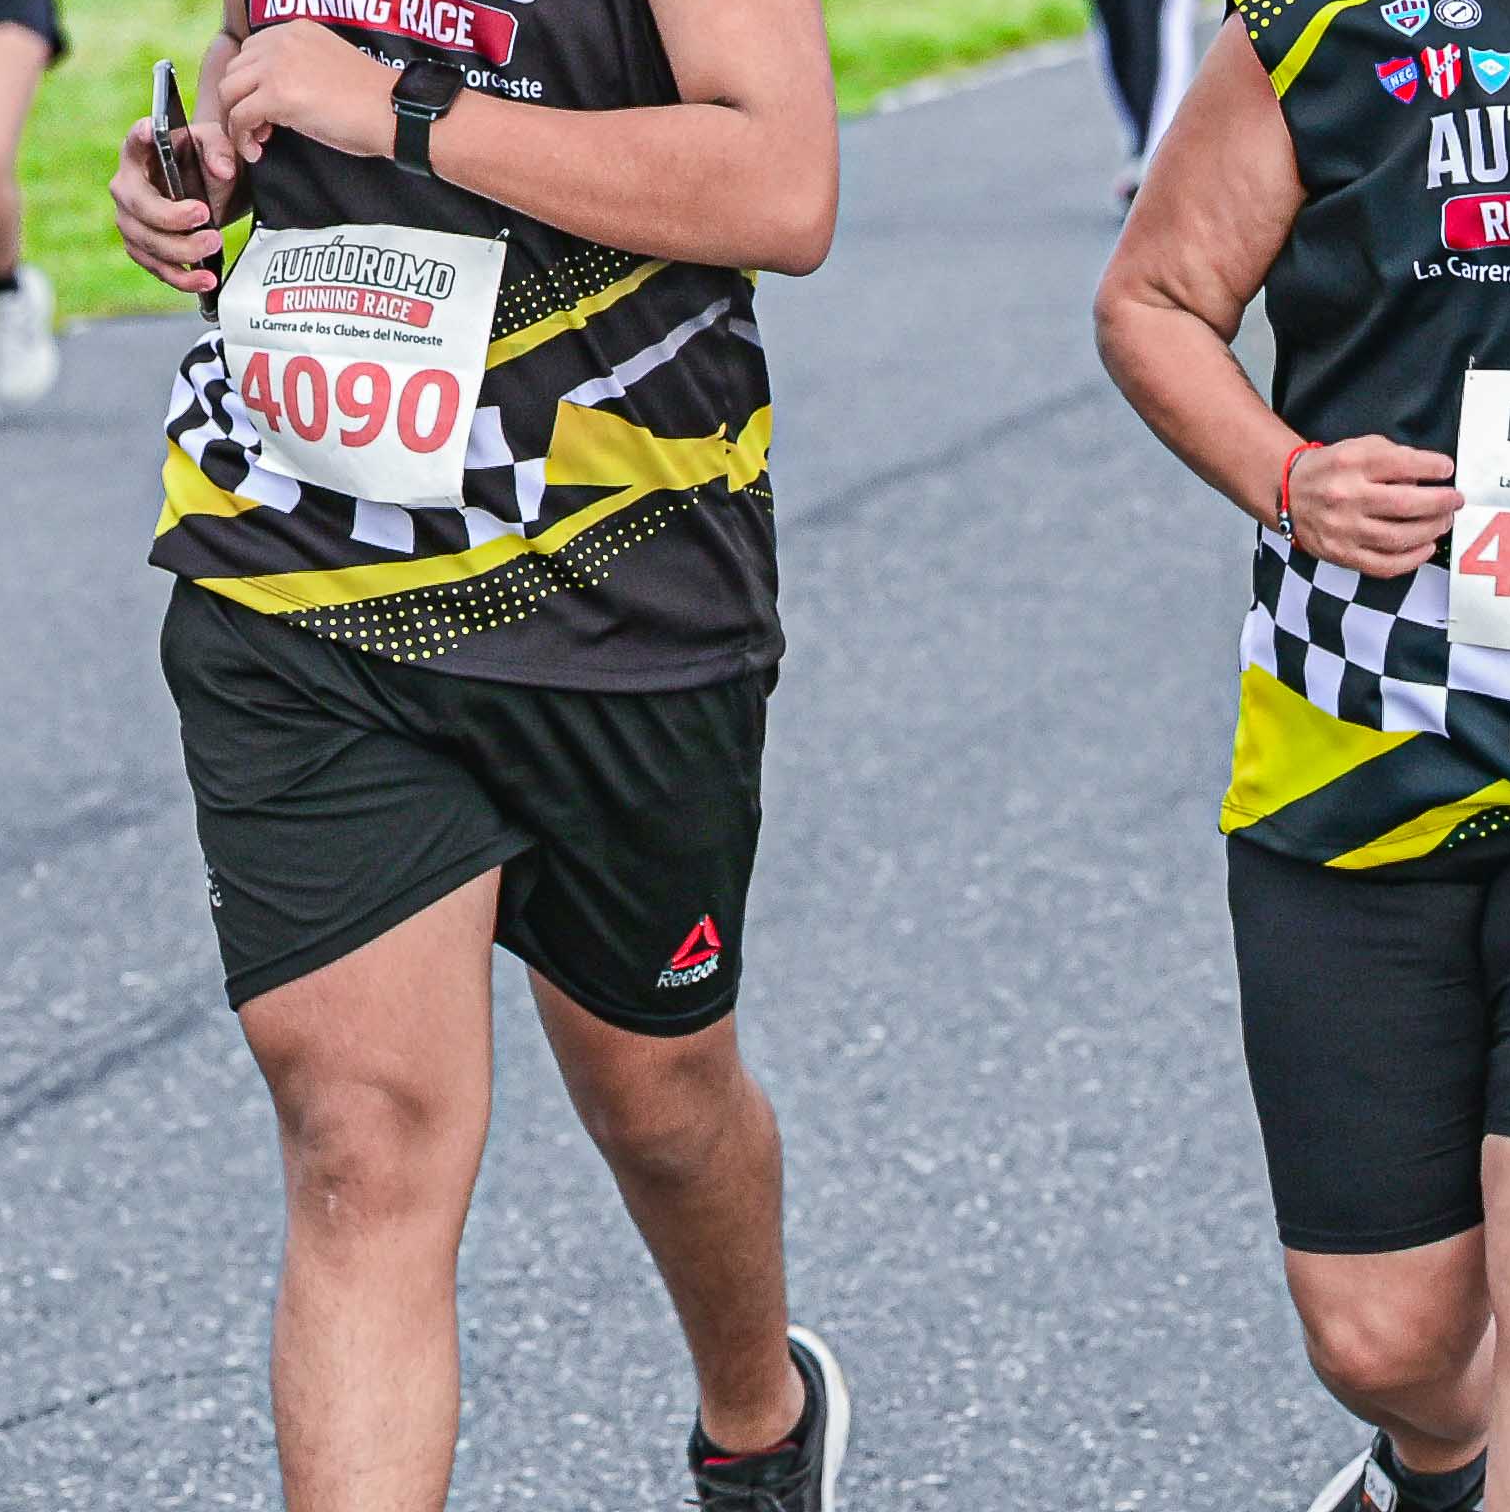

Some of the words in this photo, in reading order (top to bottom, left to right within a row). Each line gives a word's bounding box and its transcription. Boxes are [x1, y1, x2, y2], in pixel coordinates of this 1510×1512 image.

[1390, 67, 1413, 86] NEC
[263, 235, 456, 300] AUTÓDROMO
[1413, 260, 1442, 280] La
[282, 290, 359, 312] RUNNING
[363, 295, 413, 322] RACE
[249, 318, 261, 329] La
[262, 319, 298, 332] Carrera
[299, 322, 314, 333] de
[316, 323, 331, 335] los
[334, 324, 371, 339] Clubes
[373, 328, 391, 341] del
[393, 330, 443, 346] Noroeste
[241, 351, 461, 454] 4090
